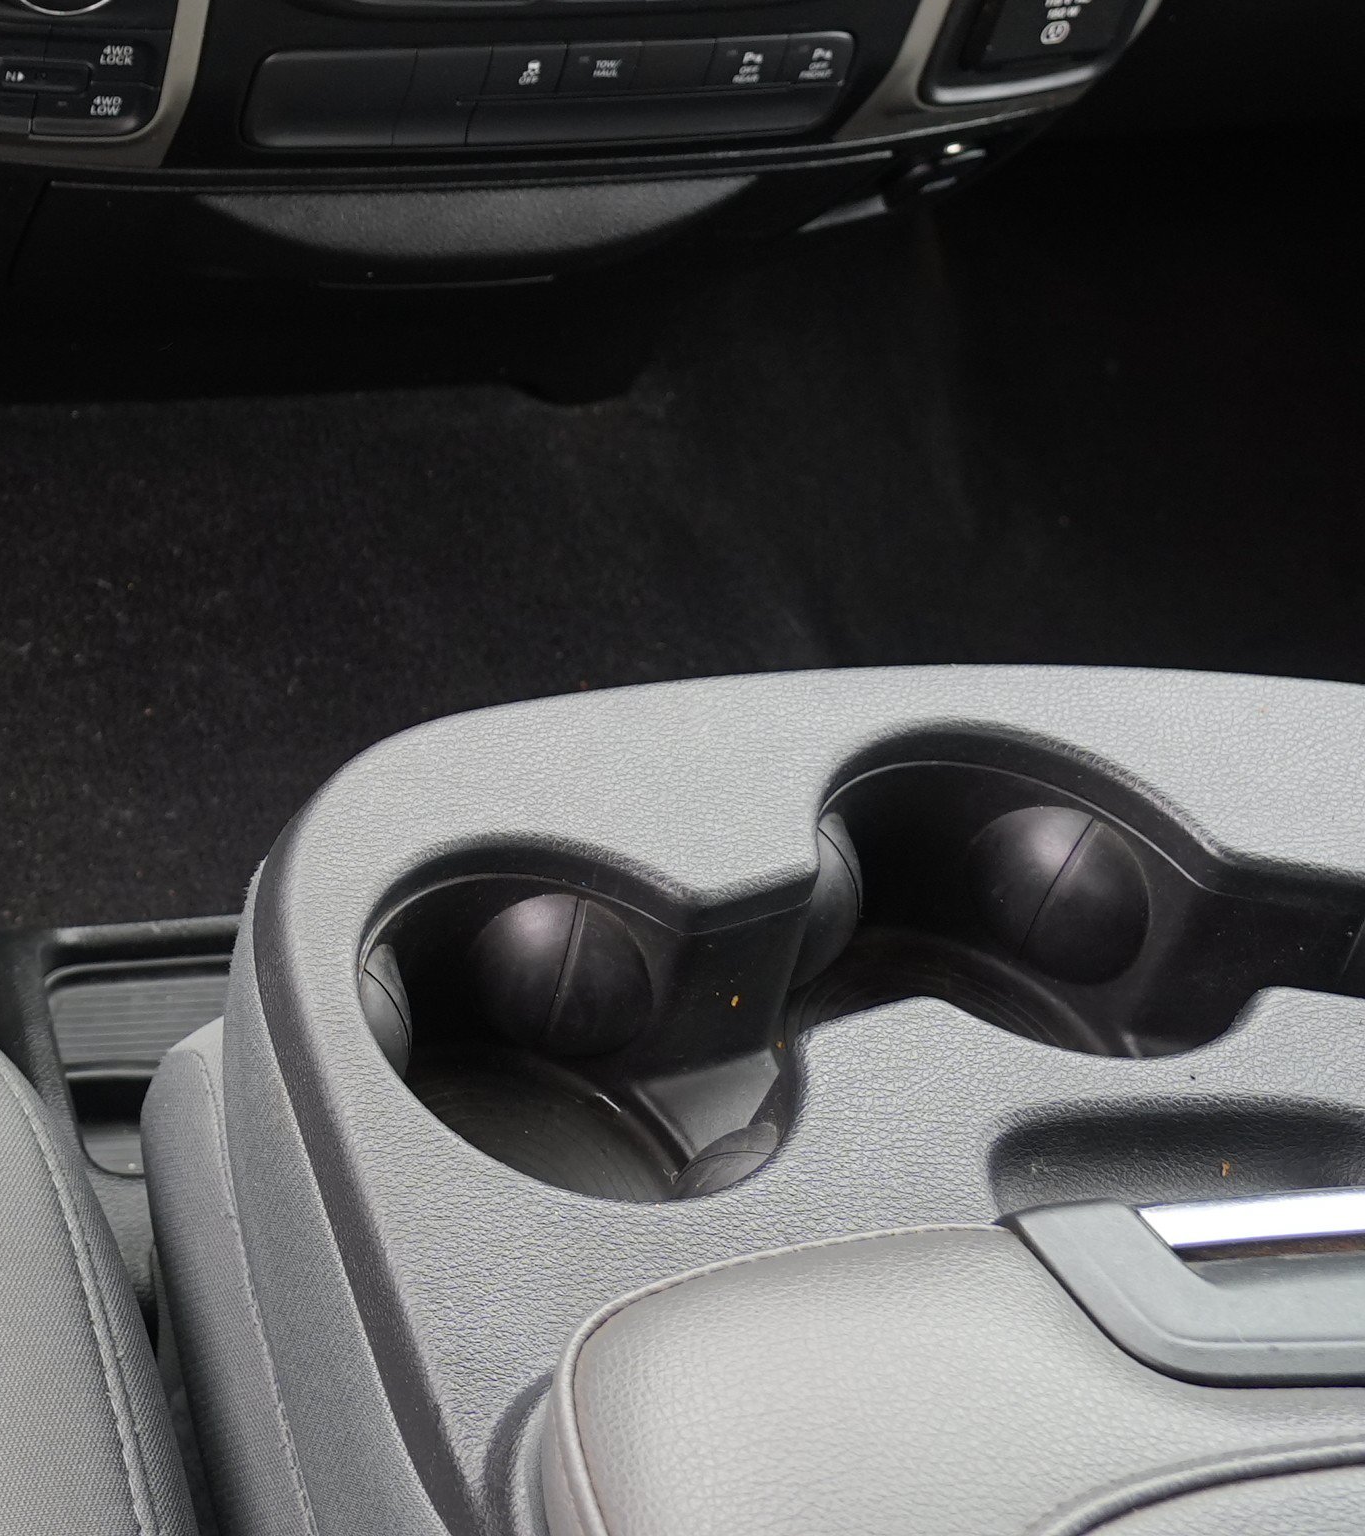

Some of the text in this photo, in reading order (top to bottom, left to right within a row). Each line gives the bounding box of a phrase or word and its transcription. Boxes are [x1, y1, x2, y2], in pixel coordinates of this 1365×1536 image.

[103, 45, 134, 56] 4WD
[99, 54, 133, 66] LOCK
[93, 95, 123, 107] 4WD
[90, 104, 121, 116] LOW
